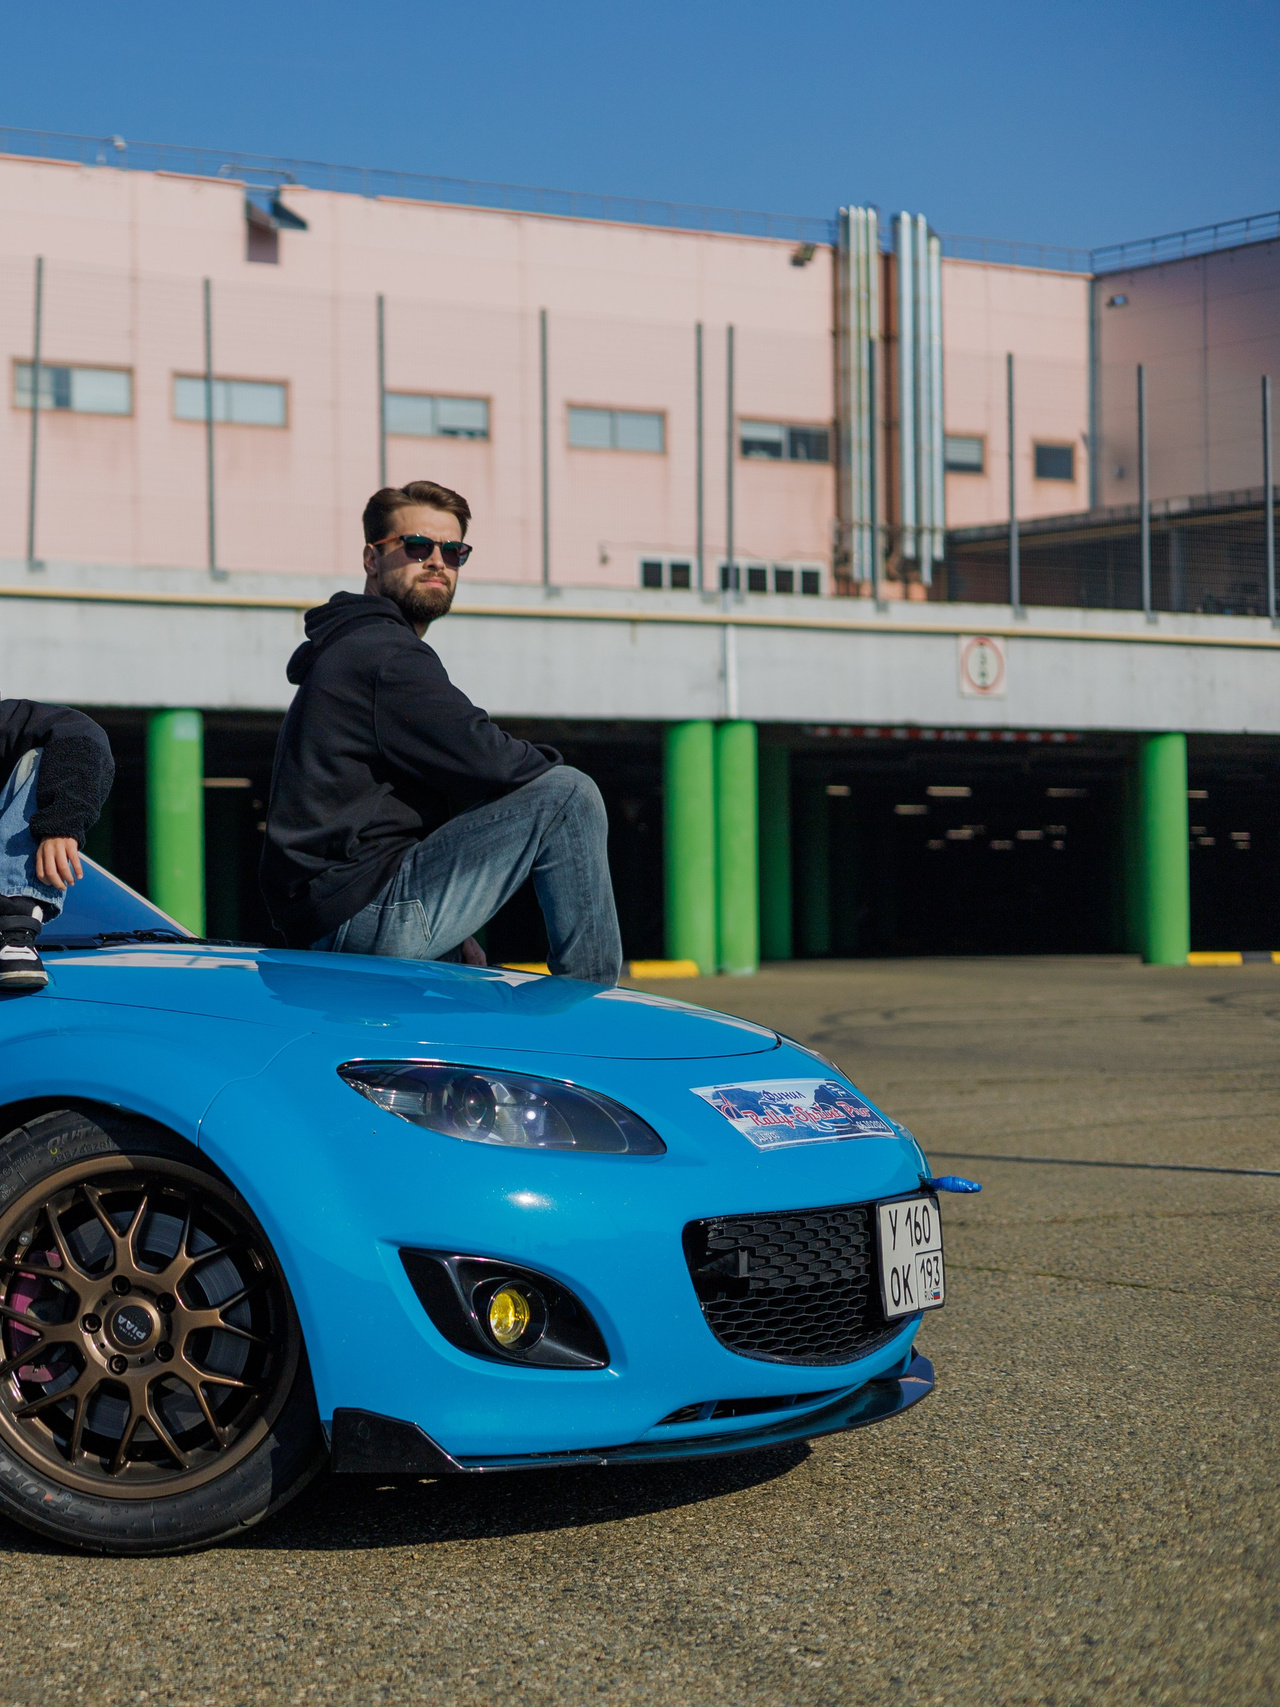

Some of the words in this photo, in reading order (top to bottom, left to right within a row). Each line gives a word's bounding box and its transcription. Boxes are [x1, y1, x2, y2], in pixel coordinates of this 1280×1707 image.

[741, 1104, 846, 1129] Rally-Sprint
[905, 1205, 931, 1248] 160
[920, 1256, 940, 1289] 193
[117, 1314, 147, 1340] PIAA
